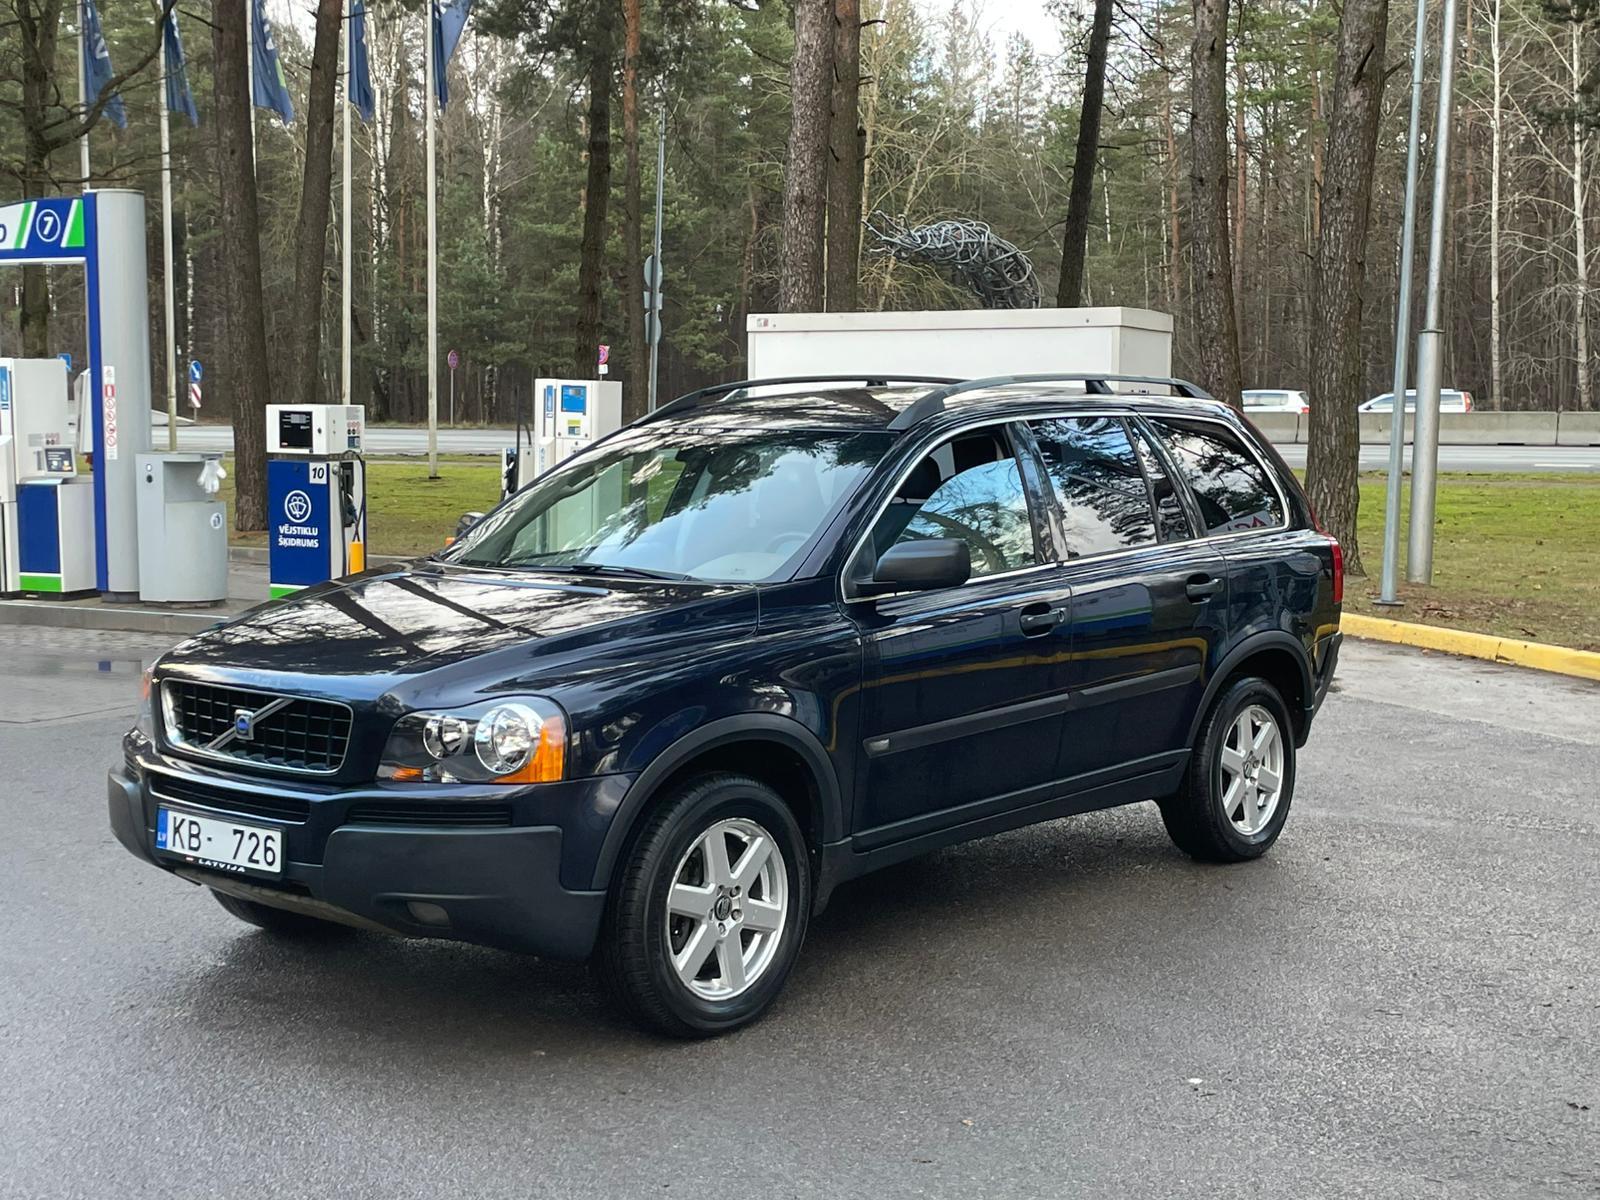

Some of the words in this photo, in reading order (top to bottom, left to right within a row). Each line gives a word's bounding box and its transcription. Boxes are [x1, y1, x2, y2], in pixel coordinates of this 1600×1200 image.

[43, 216, 54, 235] 7
[312, 467, 325, 479] 10
[278, 524, 318, 536] VĒJSTIKLU
[278, 535, 319, 549] ŠĶIDRUMS
[232, 828, 276, 867] 726
[198, 859, 246, 873] LATVIJA
